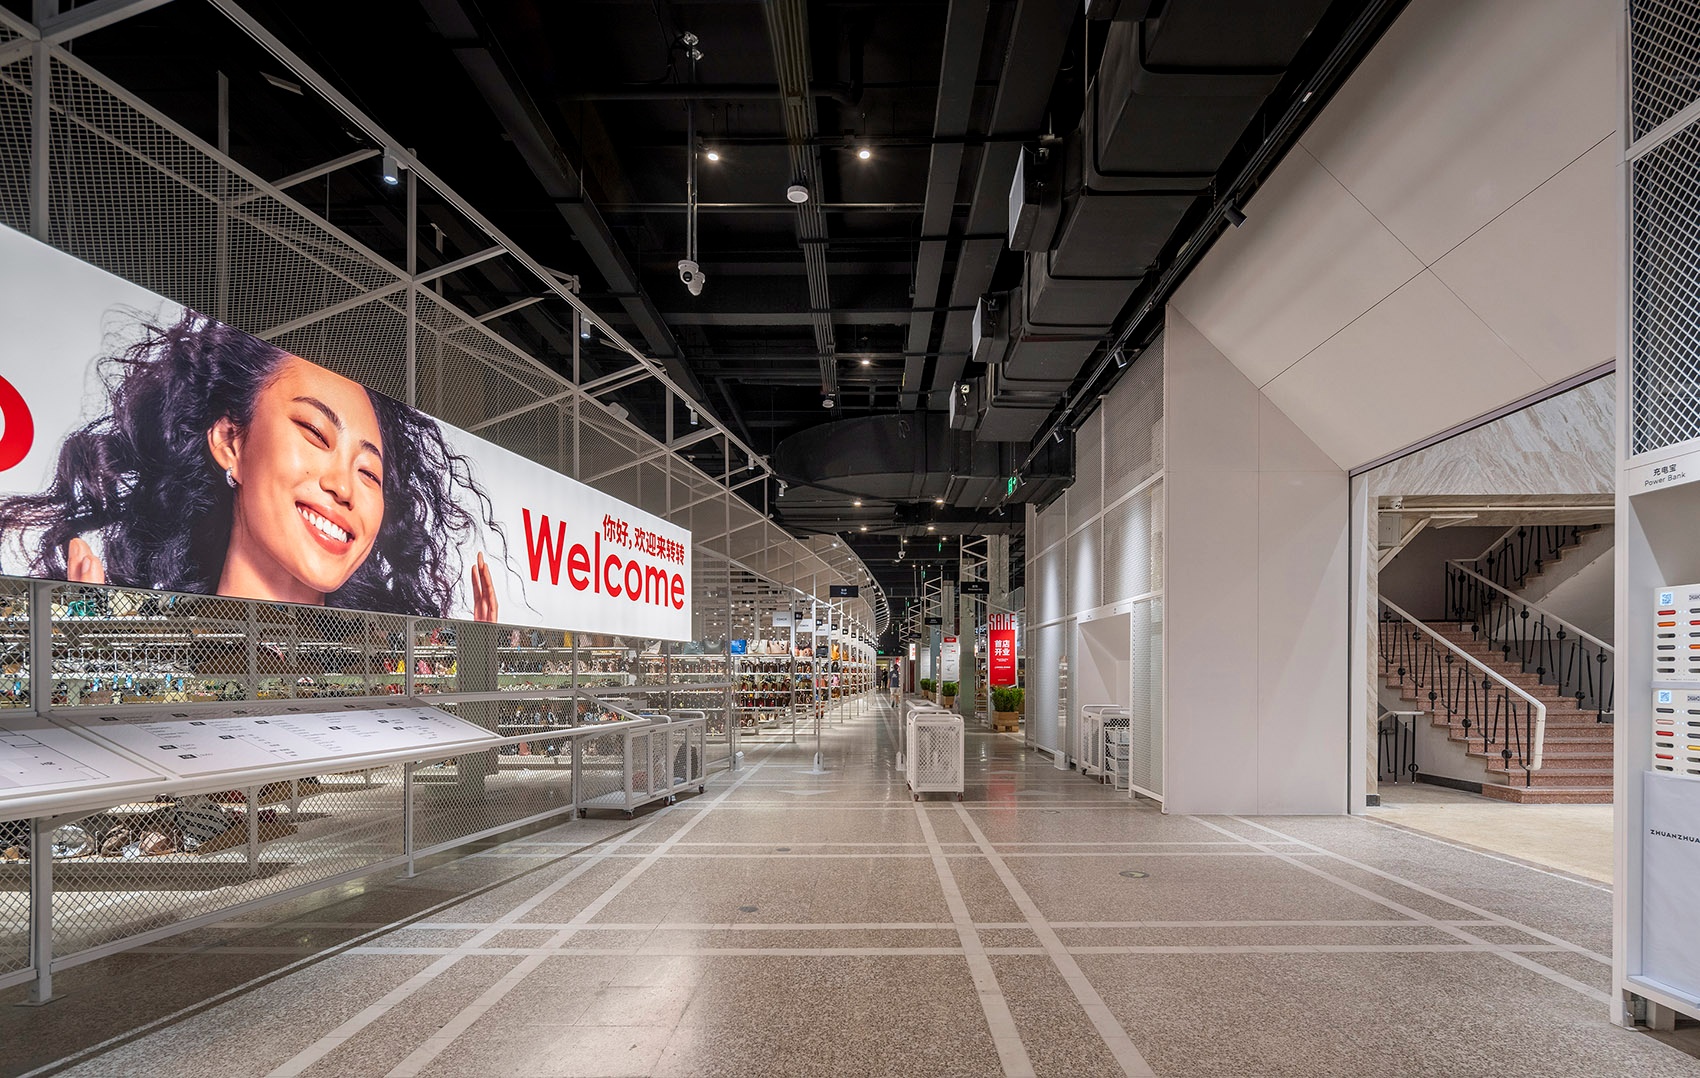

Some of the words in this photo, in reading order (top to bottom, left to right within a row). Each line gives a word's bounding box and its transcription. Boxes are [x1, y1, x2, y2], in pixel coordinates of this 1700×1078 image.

[1653, 463, 1677, 476] 充电宝
[1644, 477, 1666, 487] Power
[1668, 472, 1686, 482] Bank
[522, 507, 685, 610] Welcome
[989, 613, 1015, 630] SALE
[994, 639, 1010, 648] 首店
[994, 648, 1010, 656] 开业
